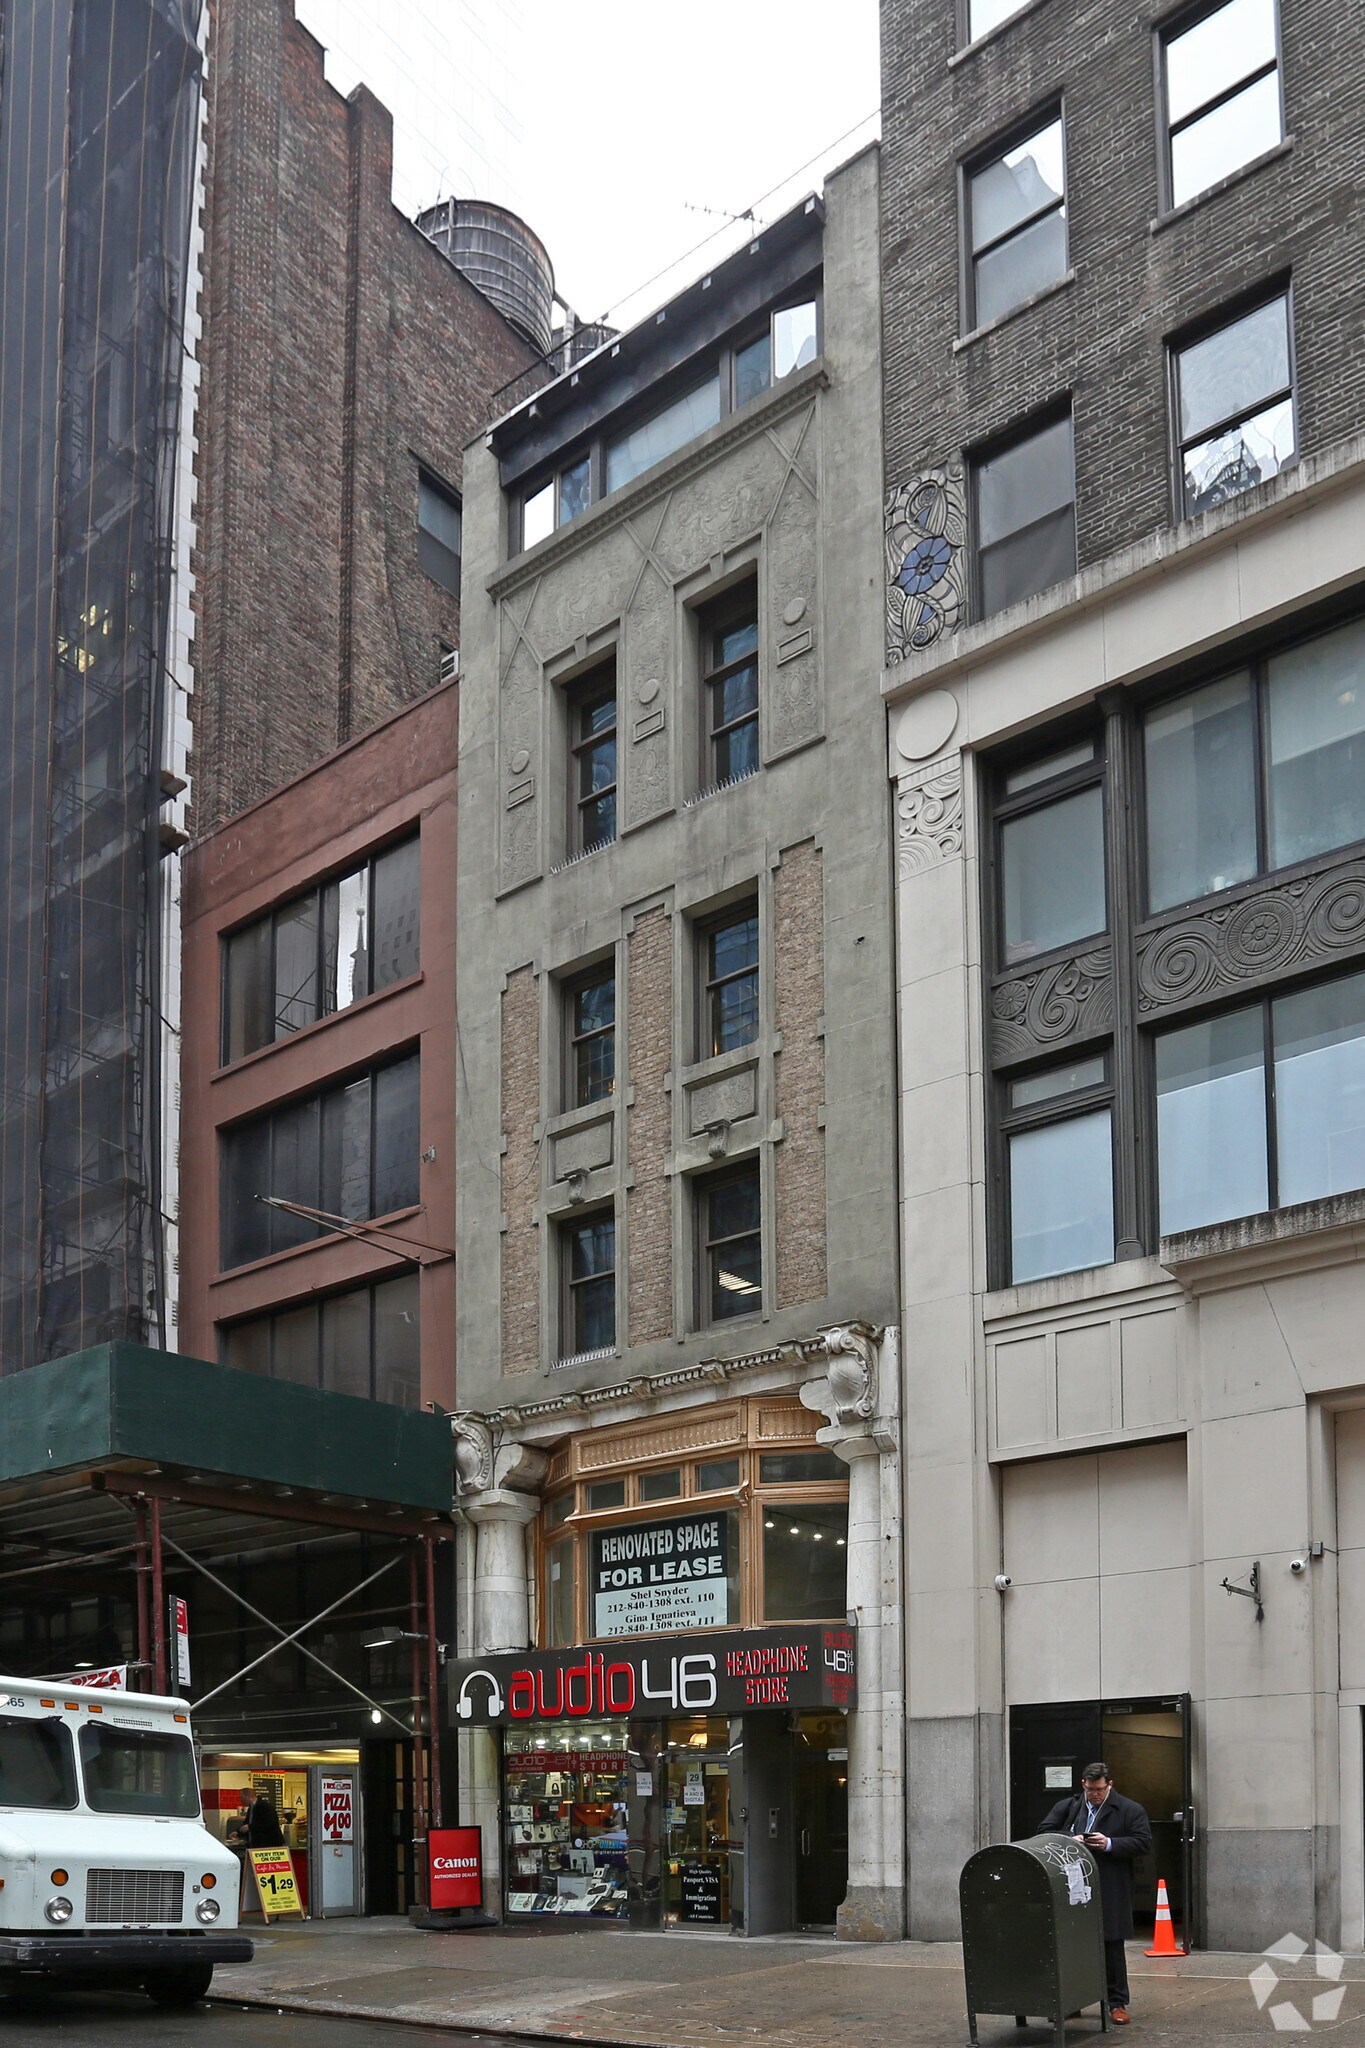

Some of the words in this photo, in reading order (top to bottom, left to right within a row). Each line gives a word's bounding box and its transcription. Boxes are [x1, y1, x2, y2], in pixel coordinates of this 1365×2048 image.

[602, 1529, 673, 1562] RENOVATED
[677, 1522, 719, 1552] SPACE
[600, 1567, 642, 1588] FOR
[650, 1555, 723, 1582] LEASE
[607, 1597, 671, 1613] 212-840-1308
[674, 1597, 693, 1605] ext.
[697, 1592, 715, 1602] 110
[630, 1591, 651, 1600] Shel
[654, 1587, 689, 1599] Snyder
[625, 1614, 648, 1623] Gina
[651, 1609, 696, 1622] Ignatieva
[608, 1621, 672, 1635] 212-840-1308
[697, 1616, 715, 1625] 111
[726, 1645, 808, 1676] HEADPHONE
[824, 1649, 847, 1671] 46
[70, 1669, 122, 1687] PIZZA
[509, 1652, 635, 1718] audio
[641, 1653, 718, 1709] 46
[745, 1677, 789, 1704] STORE
[580, 1752, 628, 1761] HEADPHONE
[580, 1761, 628, 1771] STORE
[690, 1774, 700, 1782] 29
[295, 1796, 303, 1806] A
[324, 1793, 351, 1811] PIZZA
[433, 1857, 477, 1869] Canon
[260, 1874, 293, 1895] $1.29
[685, 1894, 717, 1902] Immigration
